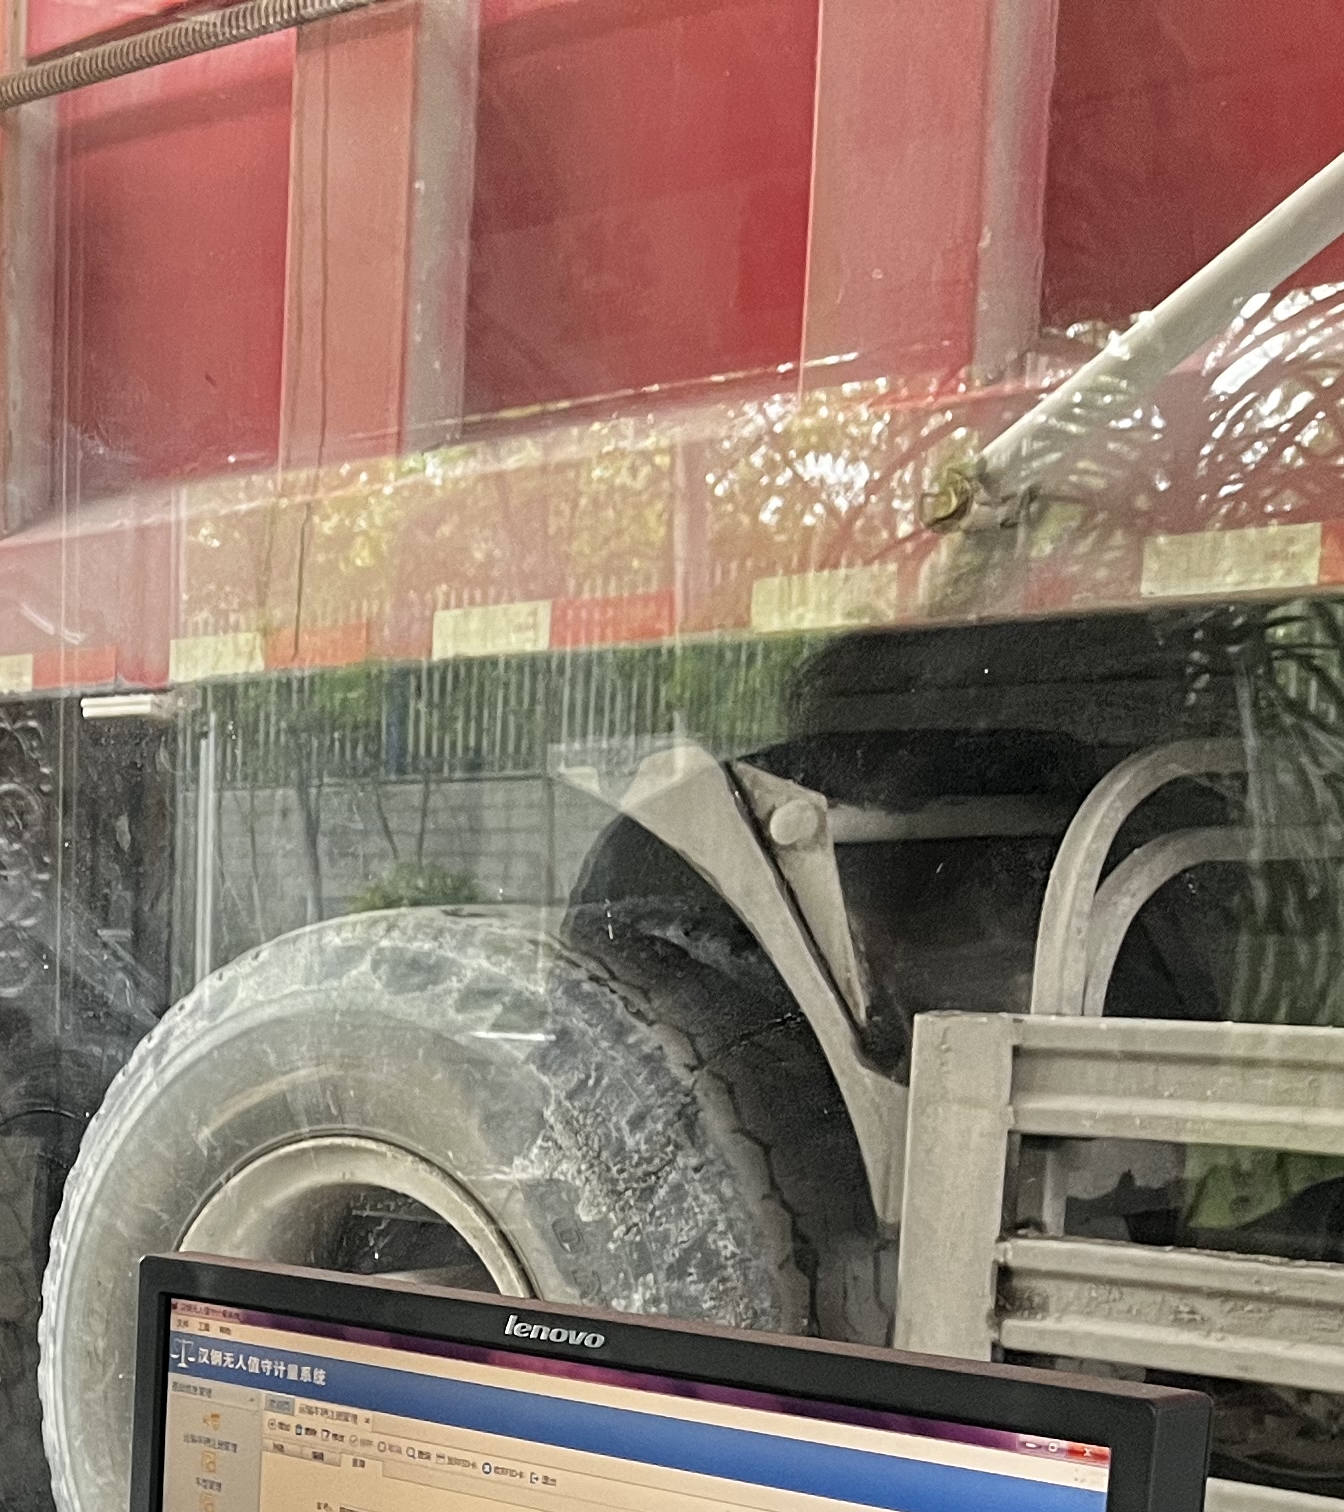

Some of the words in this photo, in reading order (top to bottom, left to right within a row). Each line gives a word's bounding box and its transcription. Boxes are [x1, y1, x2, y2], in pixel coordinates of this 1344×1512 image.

[504, 1314, 605, 1348] lenovo
[197, 1347, 327, 1387] 汉钢无人值守计量系统
